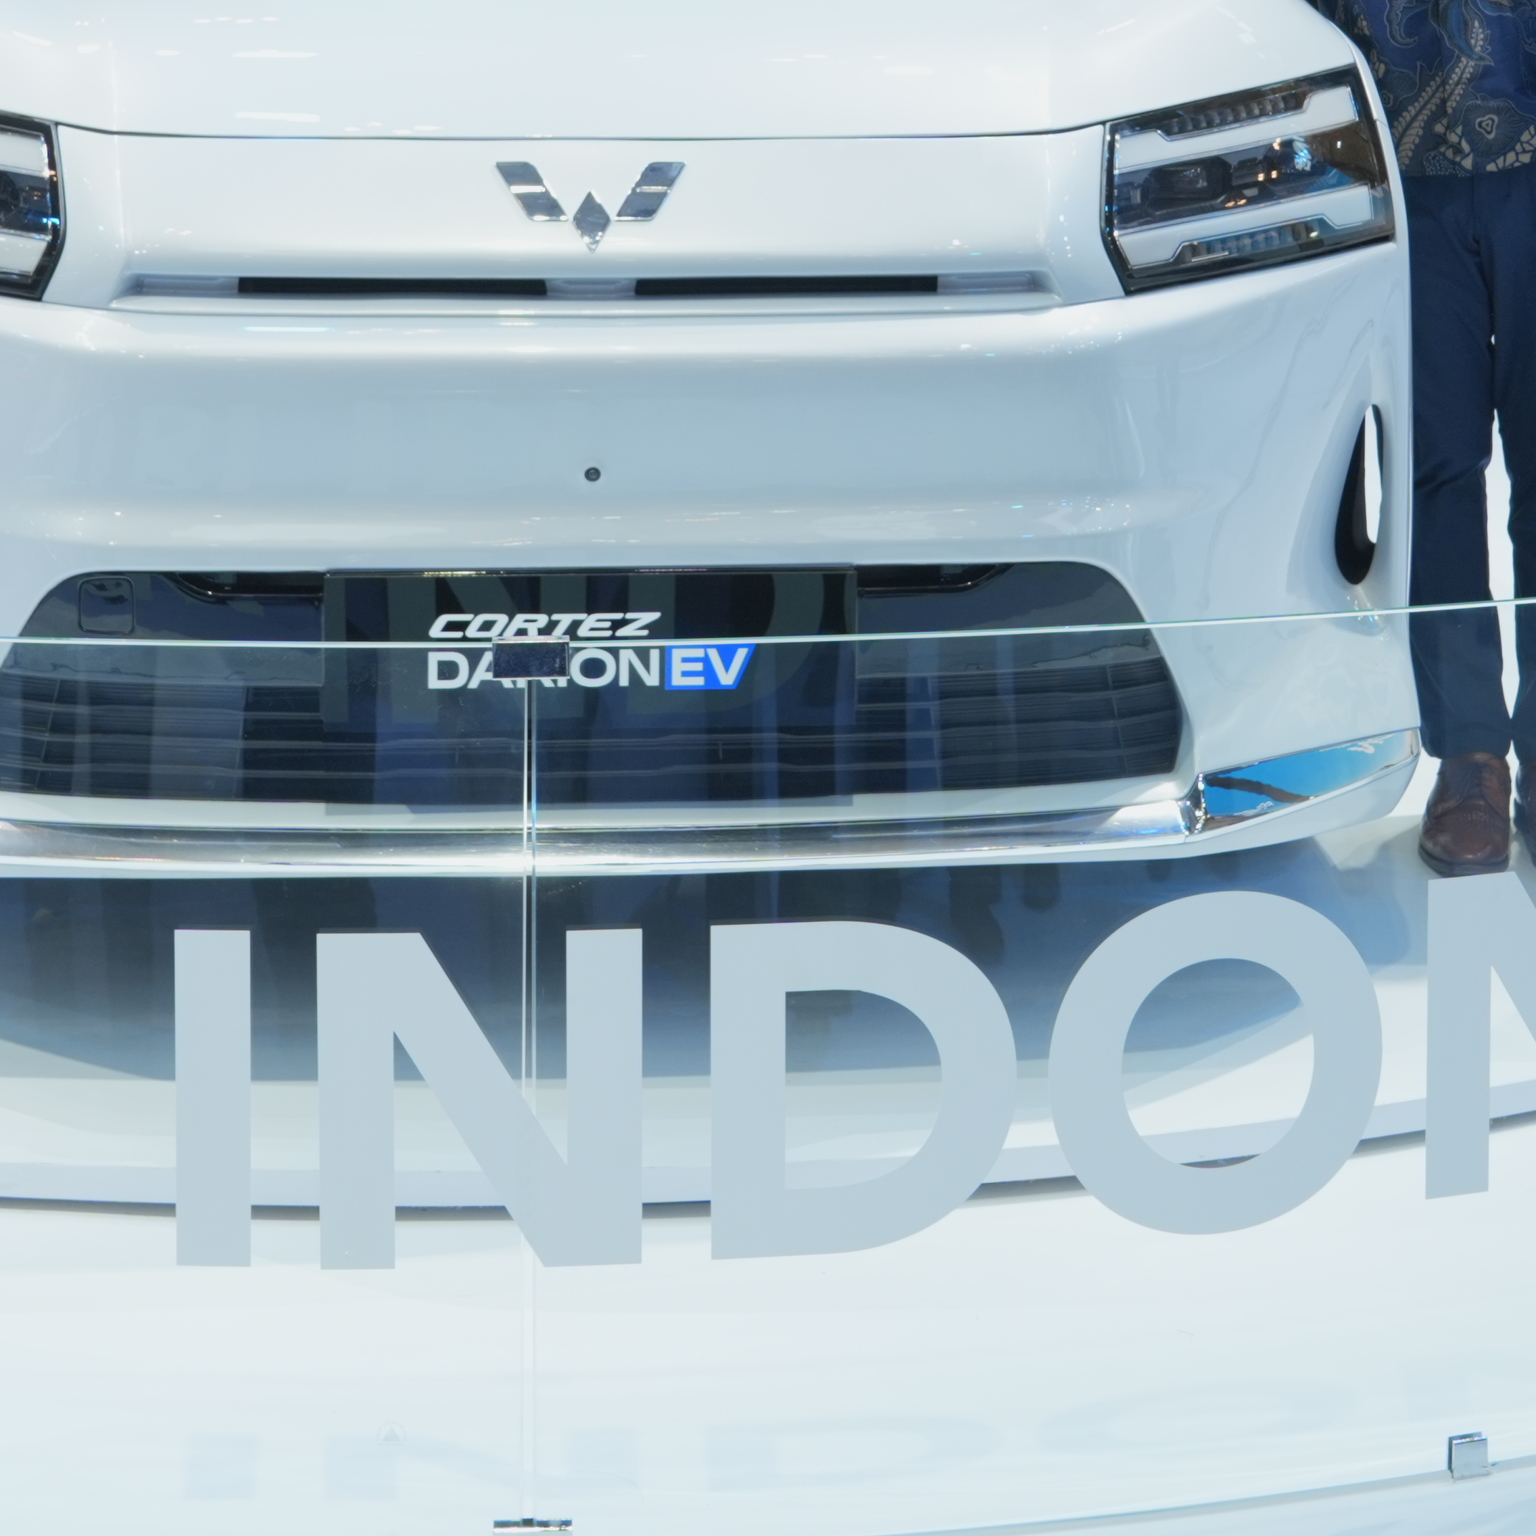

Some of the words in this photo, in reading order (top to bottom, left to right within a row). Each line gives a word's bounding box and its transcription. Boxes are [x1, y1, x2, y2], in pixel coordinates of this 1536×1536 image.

[428, 611, 661, 639] CORTEZ
[427, 647, 660, 690] DAON
[671, 647, 749, 686] EV
